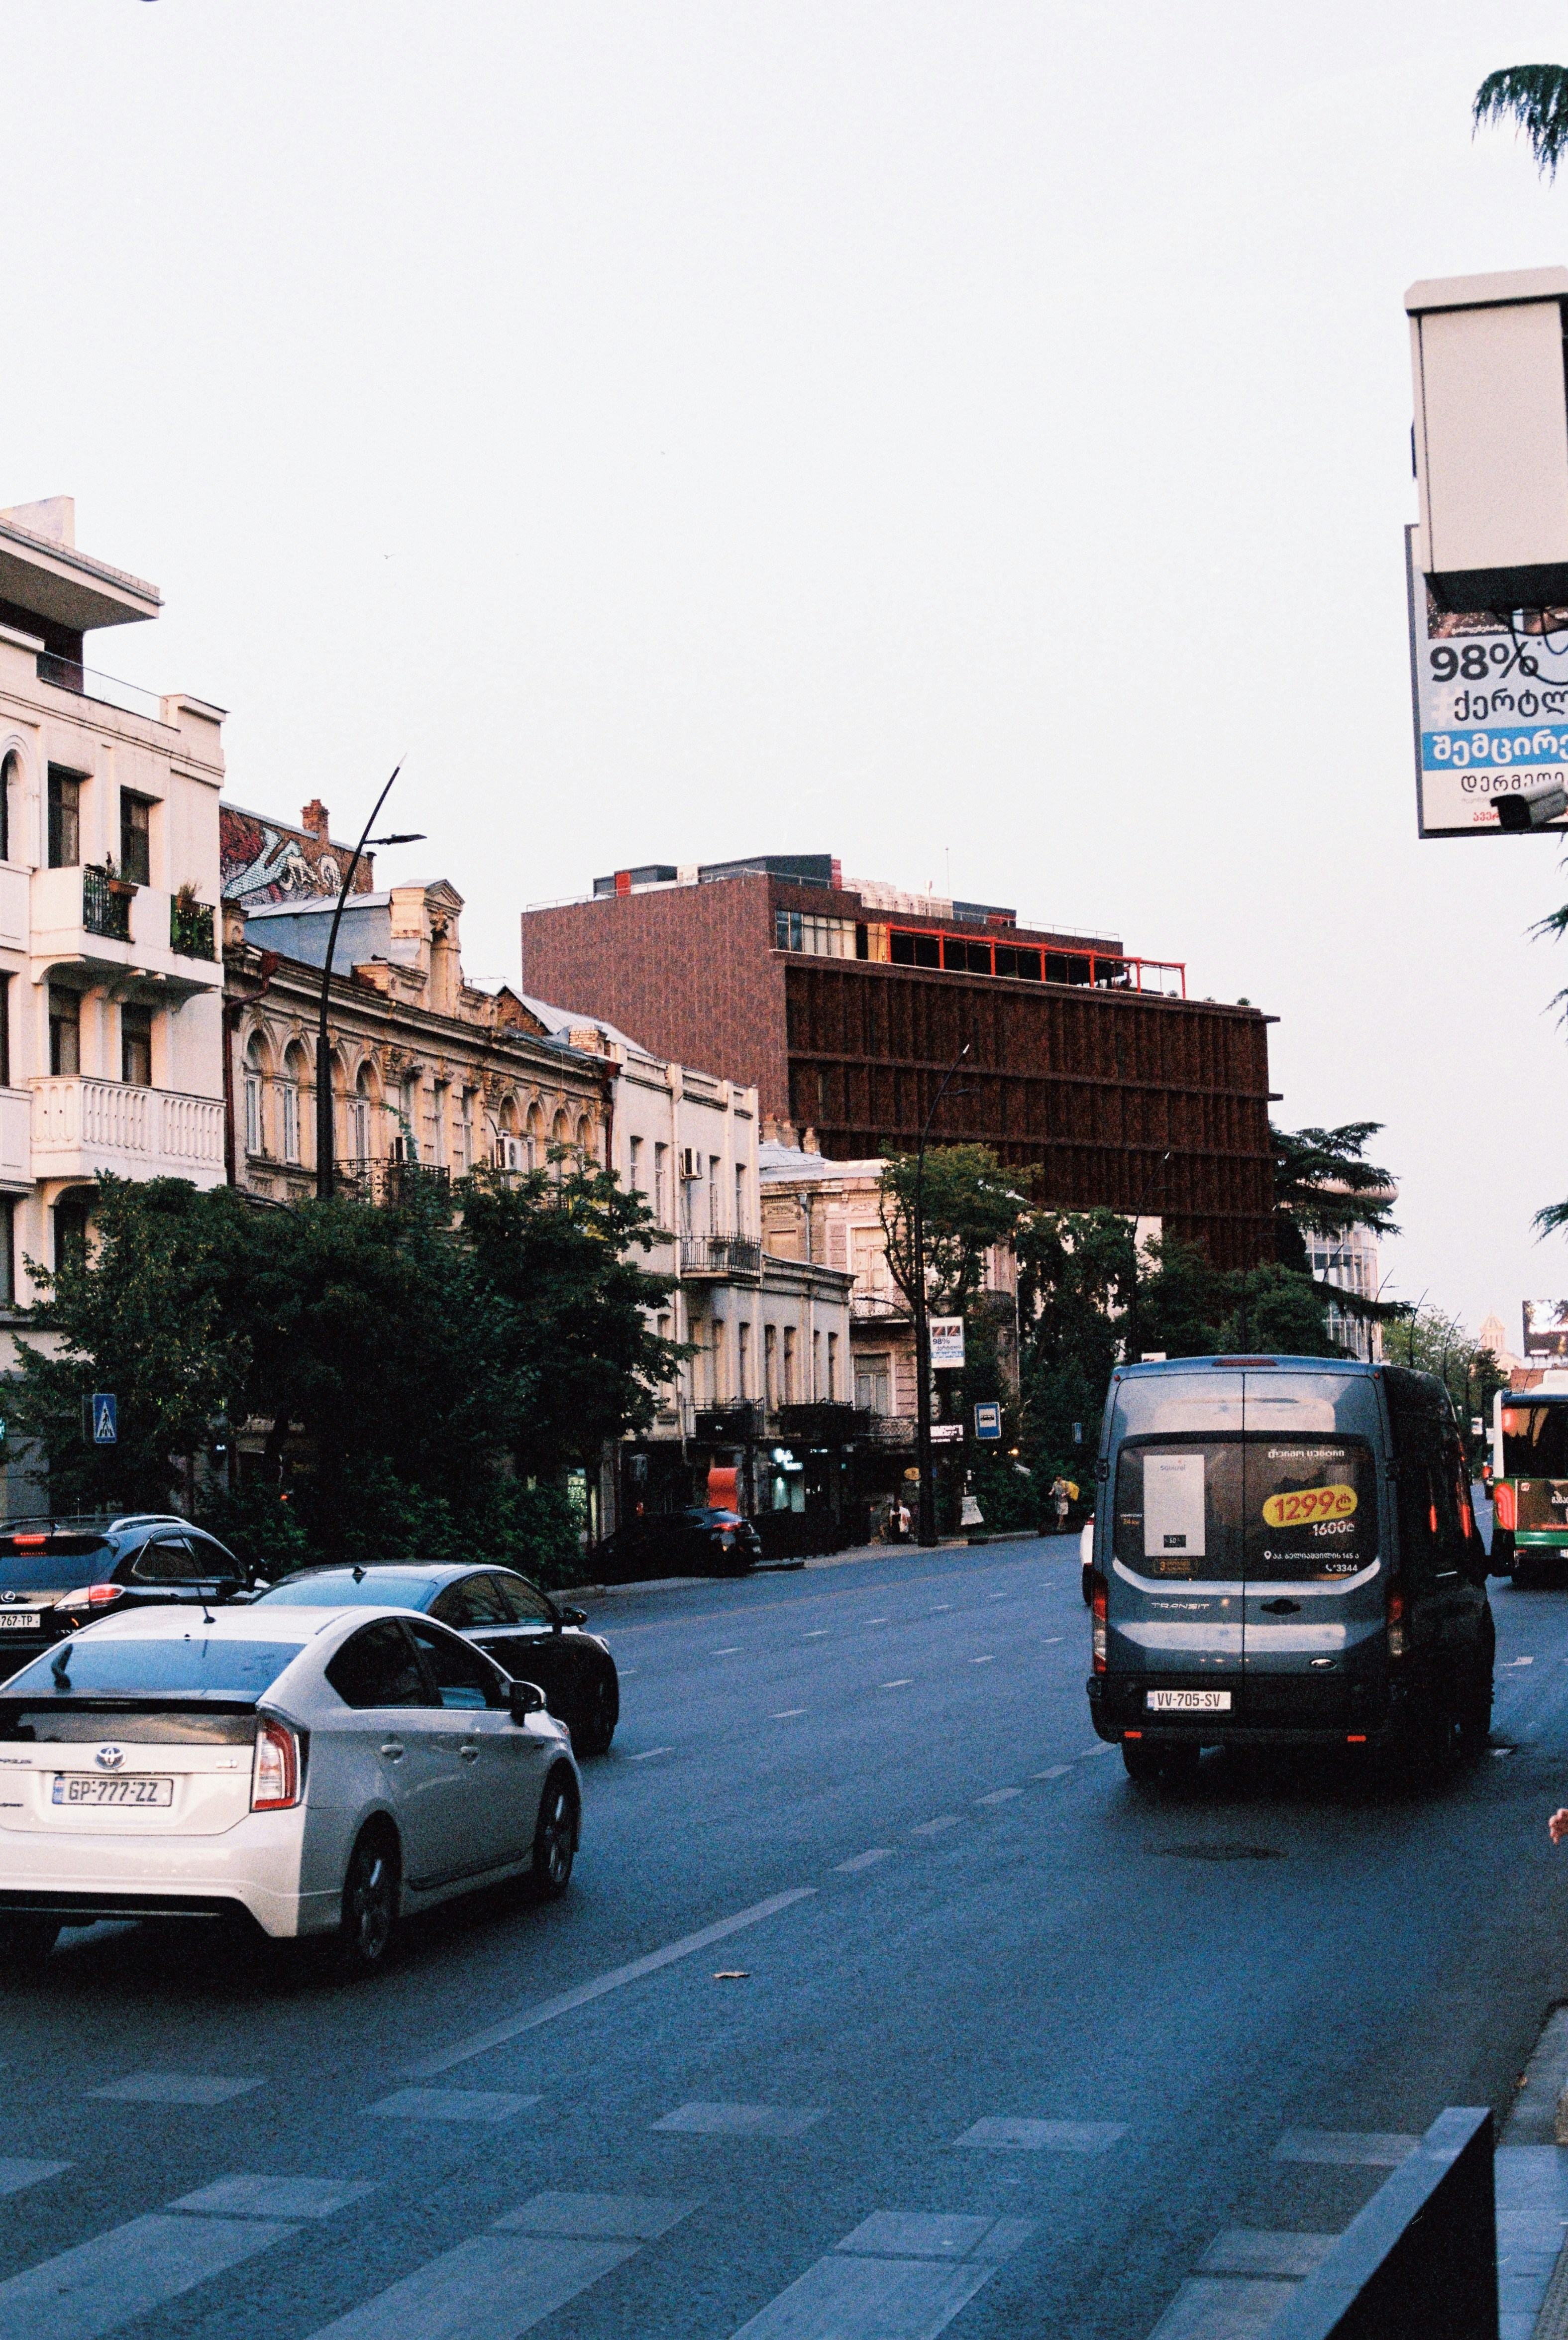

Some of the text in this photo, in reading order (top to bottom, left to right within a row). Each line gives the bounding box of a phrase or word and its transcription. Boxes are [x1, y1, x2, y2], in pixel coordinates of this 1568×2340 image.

[1430, 641, 1539, 682] 98%
[0, 1615, 33, 1626] 767-TP
[1157, 1693, 1220, 1707] VV-705-SV
[68, 1781, 159, 1802] GP-777-ZZ
